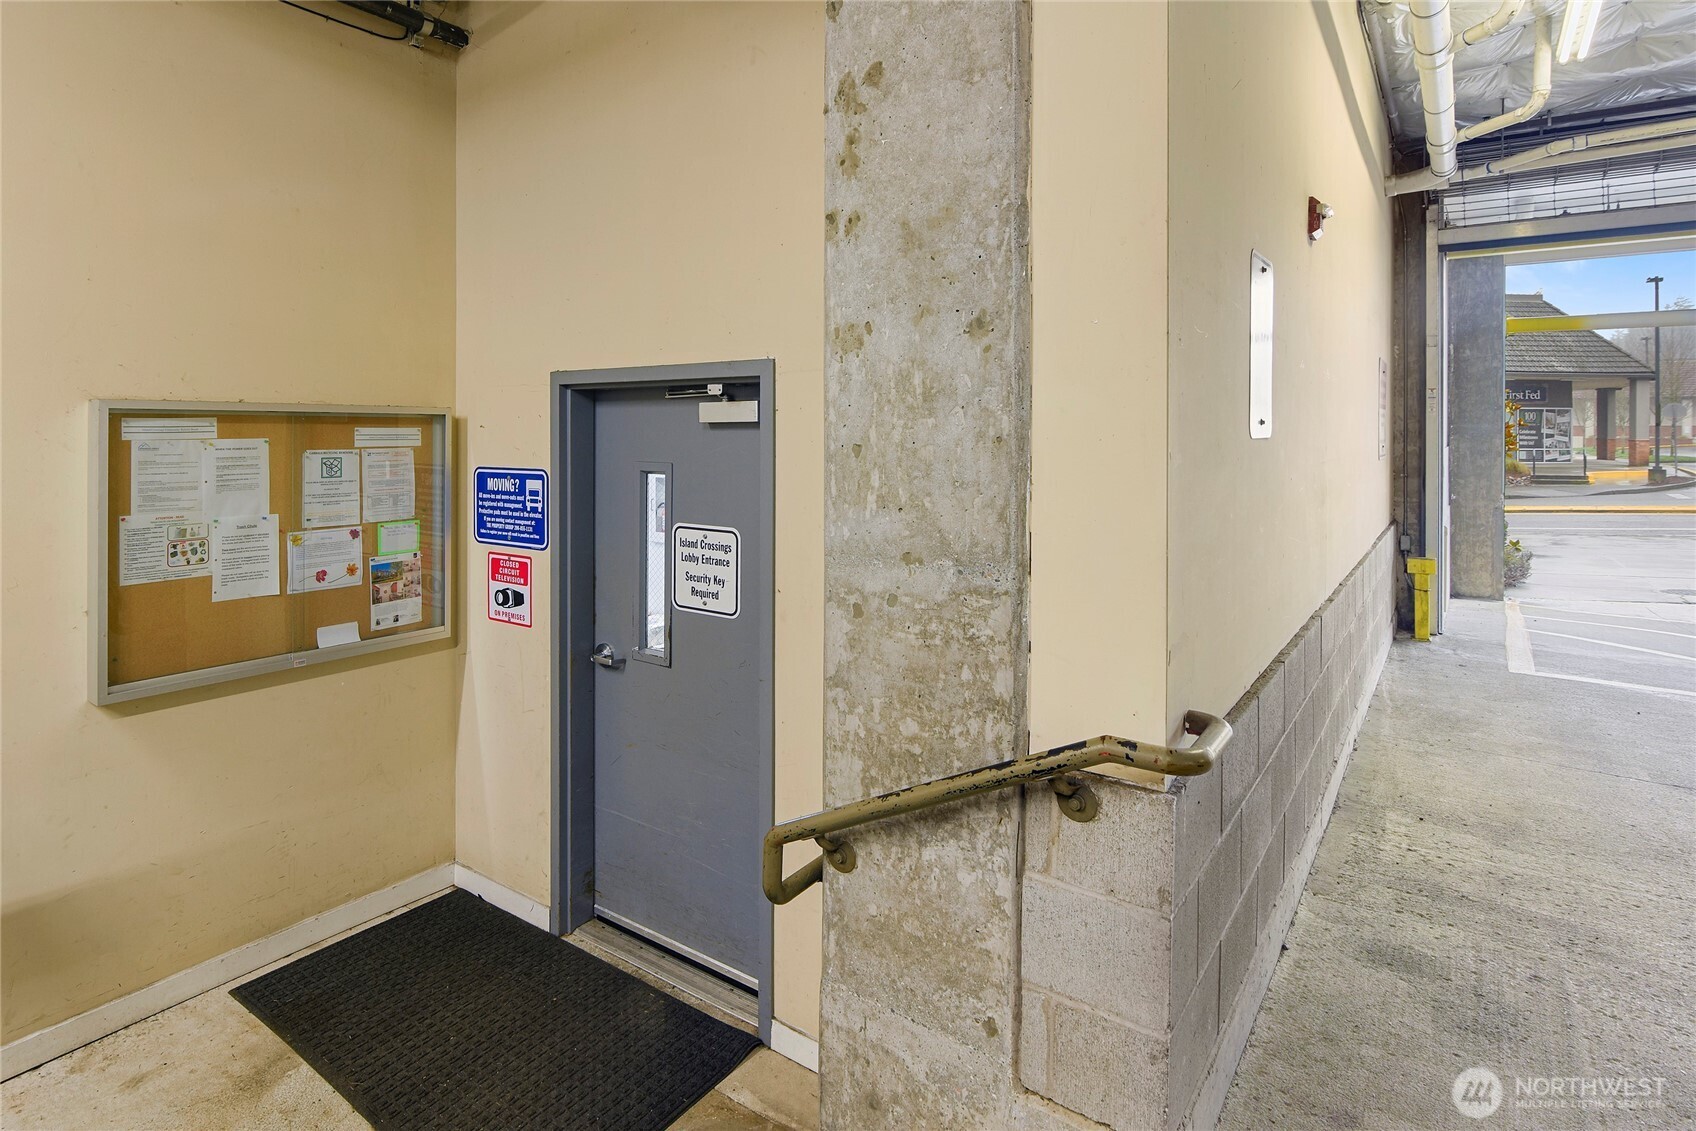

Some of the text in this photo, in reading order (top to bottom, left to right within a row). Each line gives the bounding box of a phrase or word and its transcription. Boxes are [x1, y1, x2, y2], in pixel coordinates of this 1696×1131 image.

[1526, 390, 1540, 400] Fed
[1525, 412, 1536, 420] 100
[488, 478, 519, 492] MOVING?
[680, 537, 731, 554] Island Crossings
[500, 560, 519, 568] CLOSED
[681, 552, 730, 567] Lobby Entrance
[495, 574, 524, 584] TELEVISION
[685, 571, 725, 588] Security Key
[691, 586, 719, 600] Required
[502, 611, 525, 621] PREMISES
